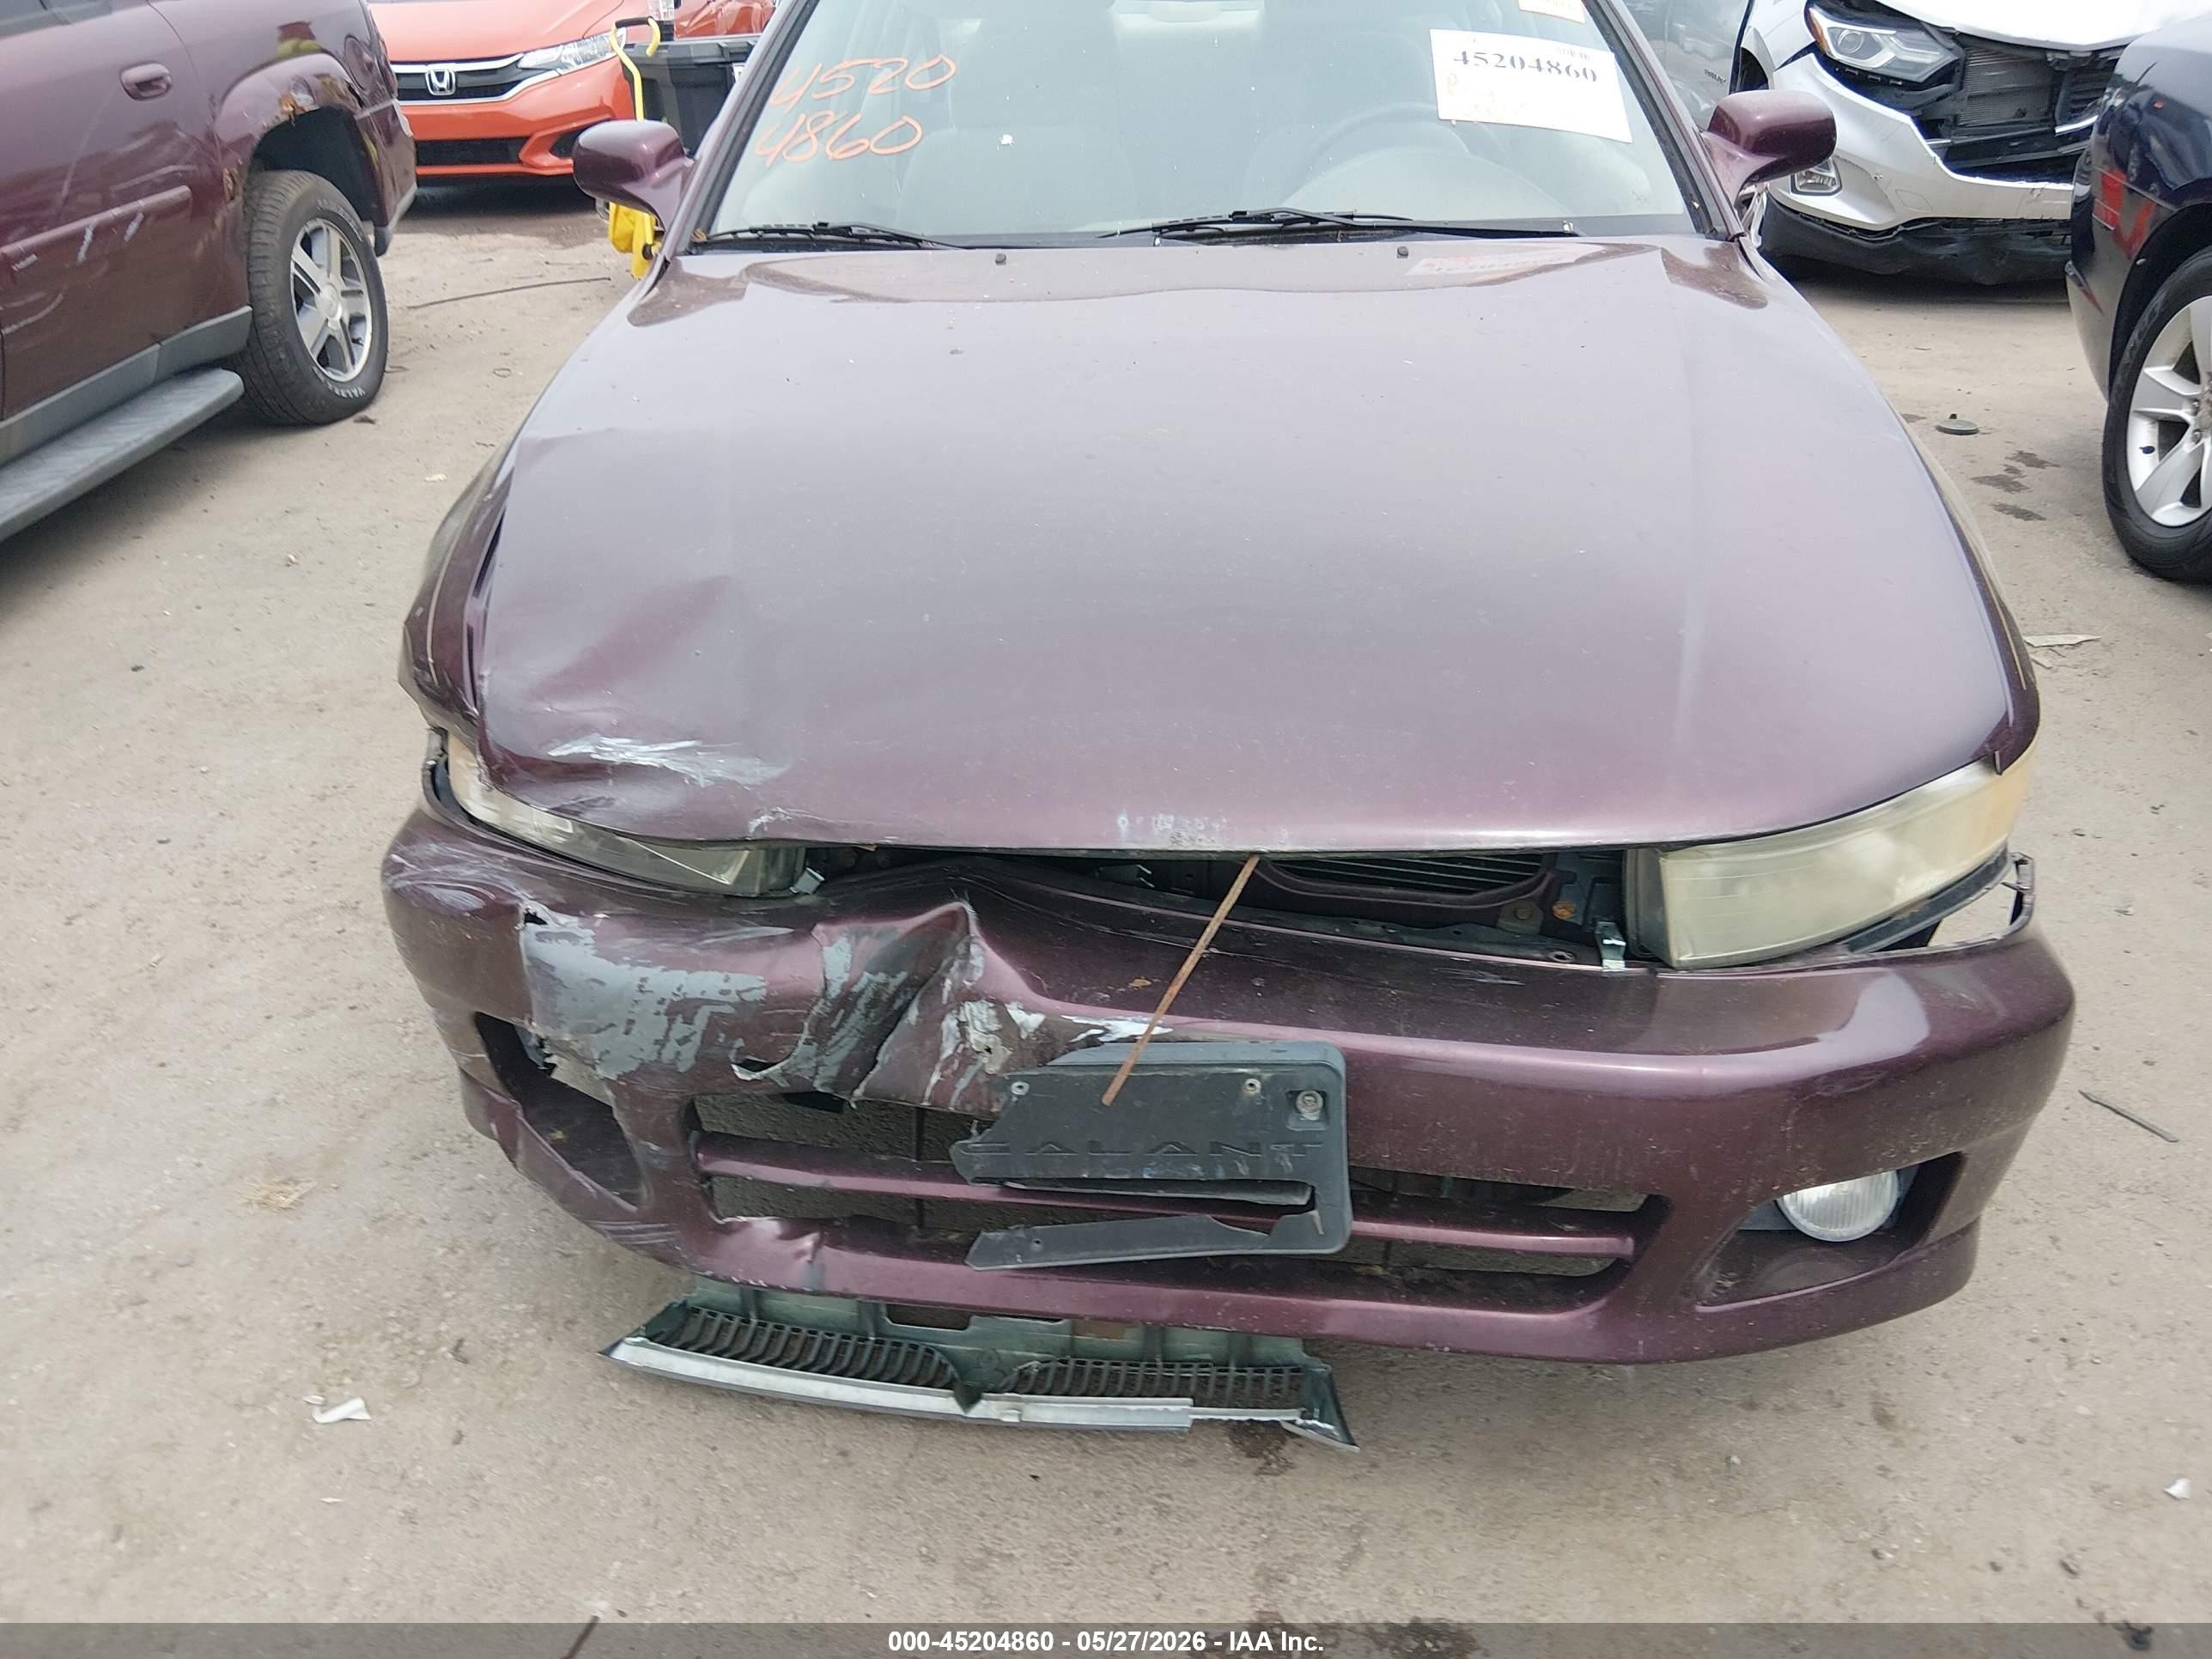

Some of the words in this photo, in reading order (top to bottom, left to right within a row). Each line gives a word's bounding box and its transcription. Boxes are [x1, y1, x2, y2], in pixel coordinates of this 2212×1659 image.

[769, 54, 956, 115] 4520
[1454, 50, 1598, 82] 45204860
[756, 110, 923, 167] 4860
[957, 1139, 1324, 1157] GALANT
